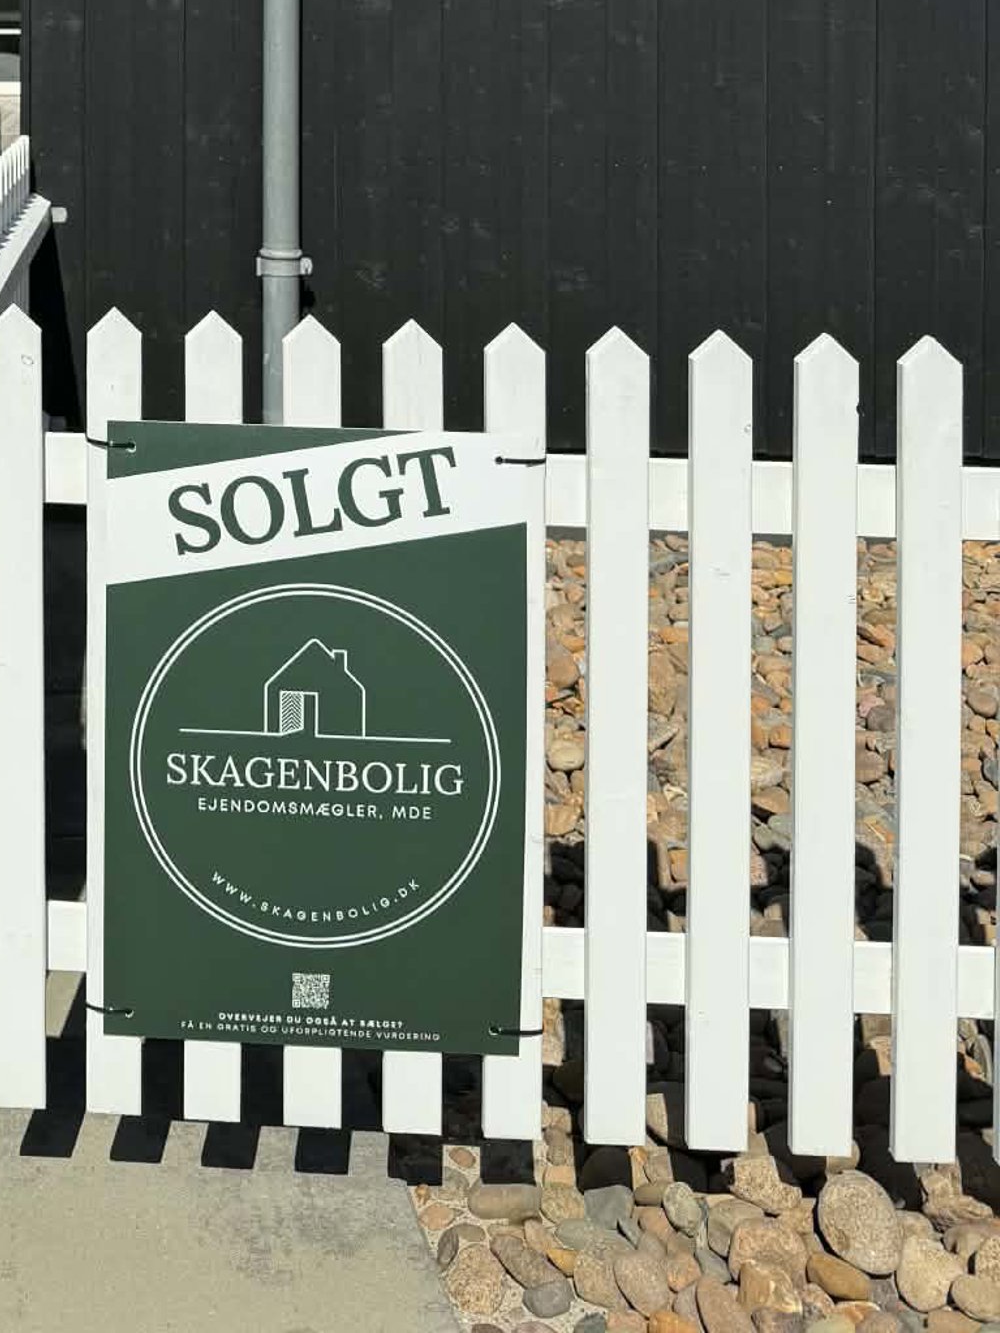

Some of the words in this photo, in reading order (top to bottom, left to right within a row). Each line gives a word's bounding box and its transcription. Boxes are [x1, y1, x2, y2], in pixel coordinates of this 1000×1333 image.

[168, 447, 456, 555] SOLGT
[166, 752, 464, 796] SKAGENBOLIG
[198, 798, 383, 819] EJENDOMSMÆGLER,
[392, 806, 432, 819] MDE
[212, 871, 420, 923] WWW.SKAGENBOLIG.DK
[181, 1020, 194, 1029] FÅ
[217, 1023, 256, 1032] GRATIS
[218, 1012, 282, 1023] OVERVEJER
[342, 1019, 355, 1027] AT
